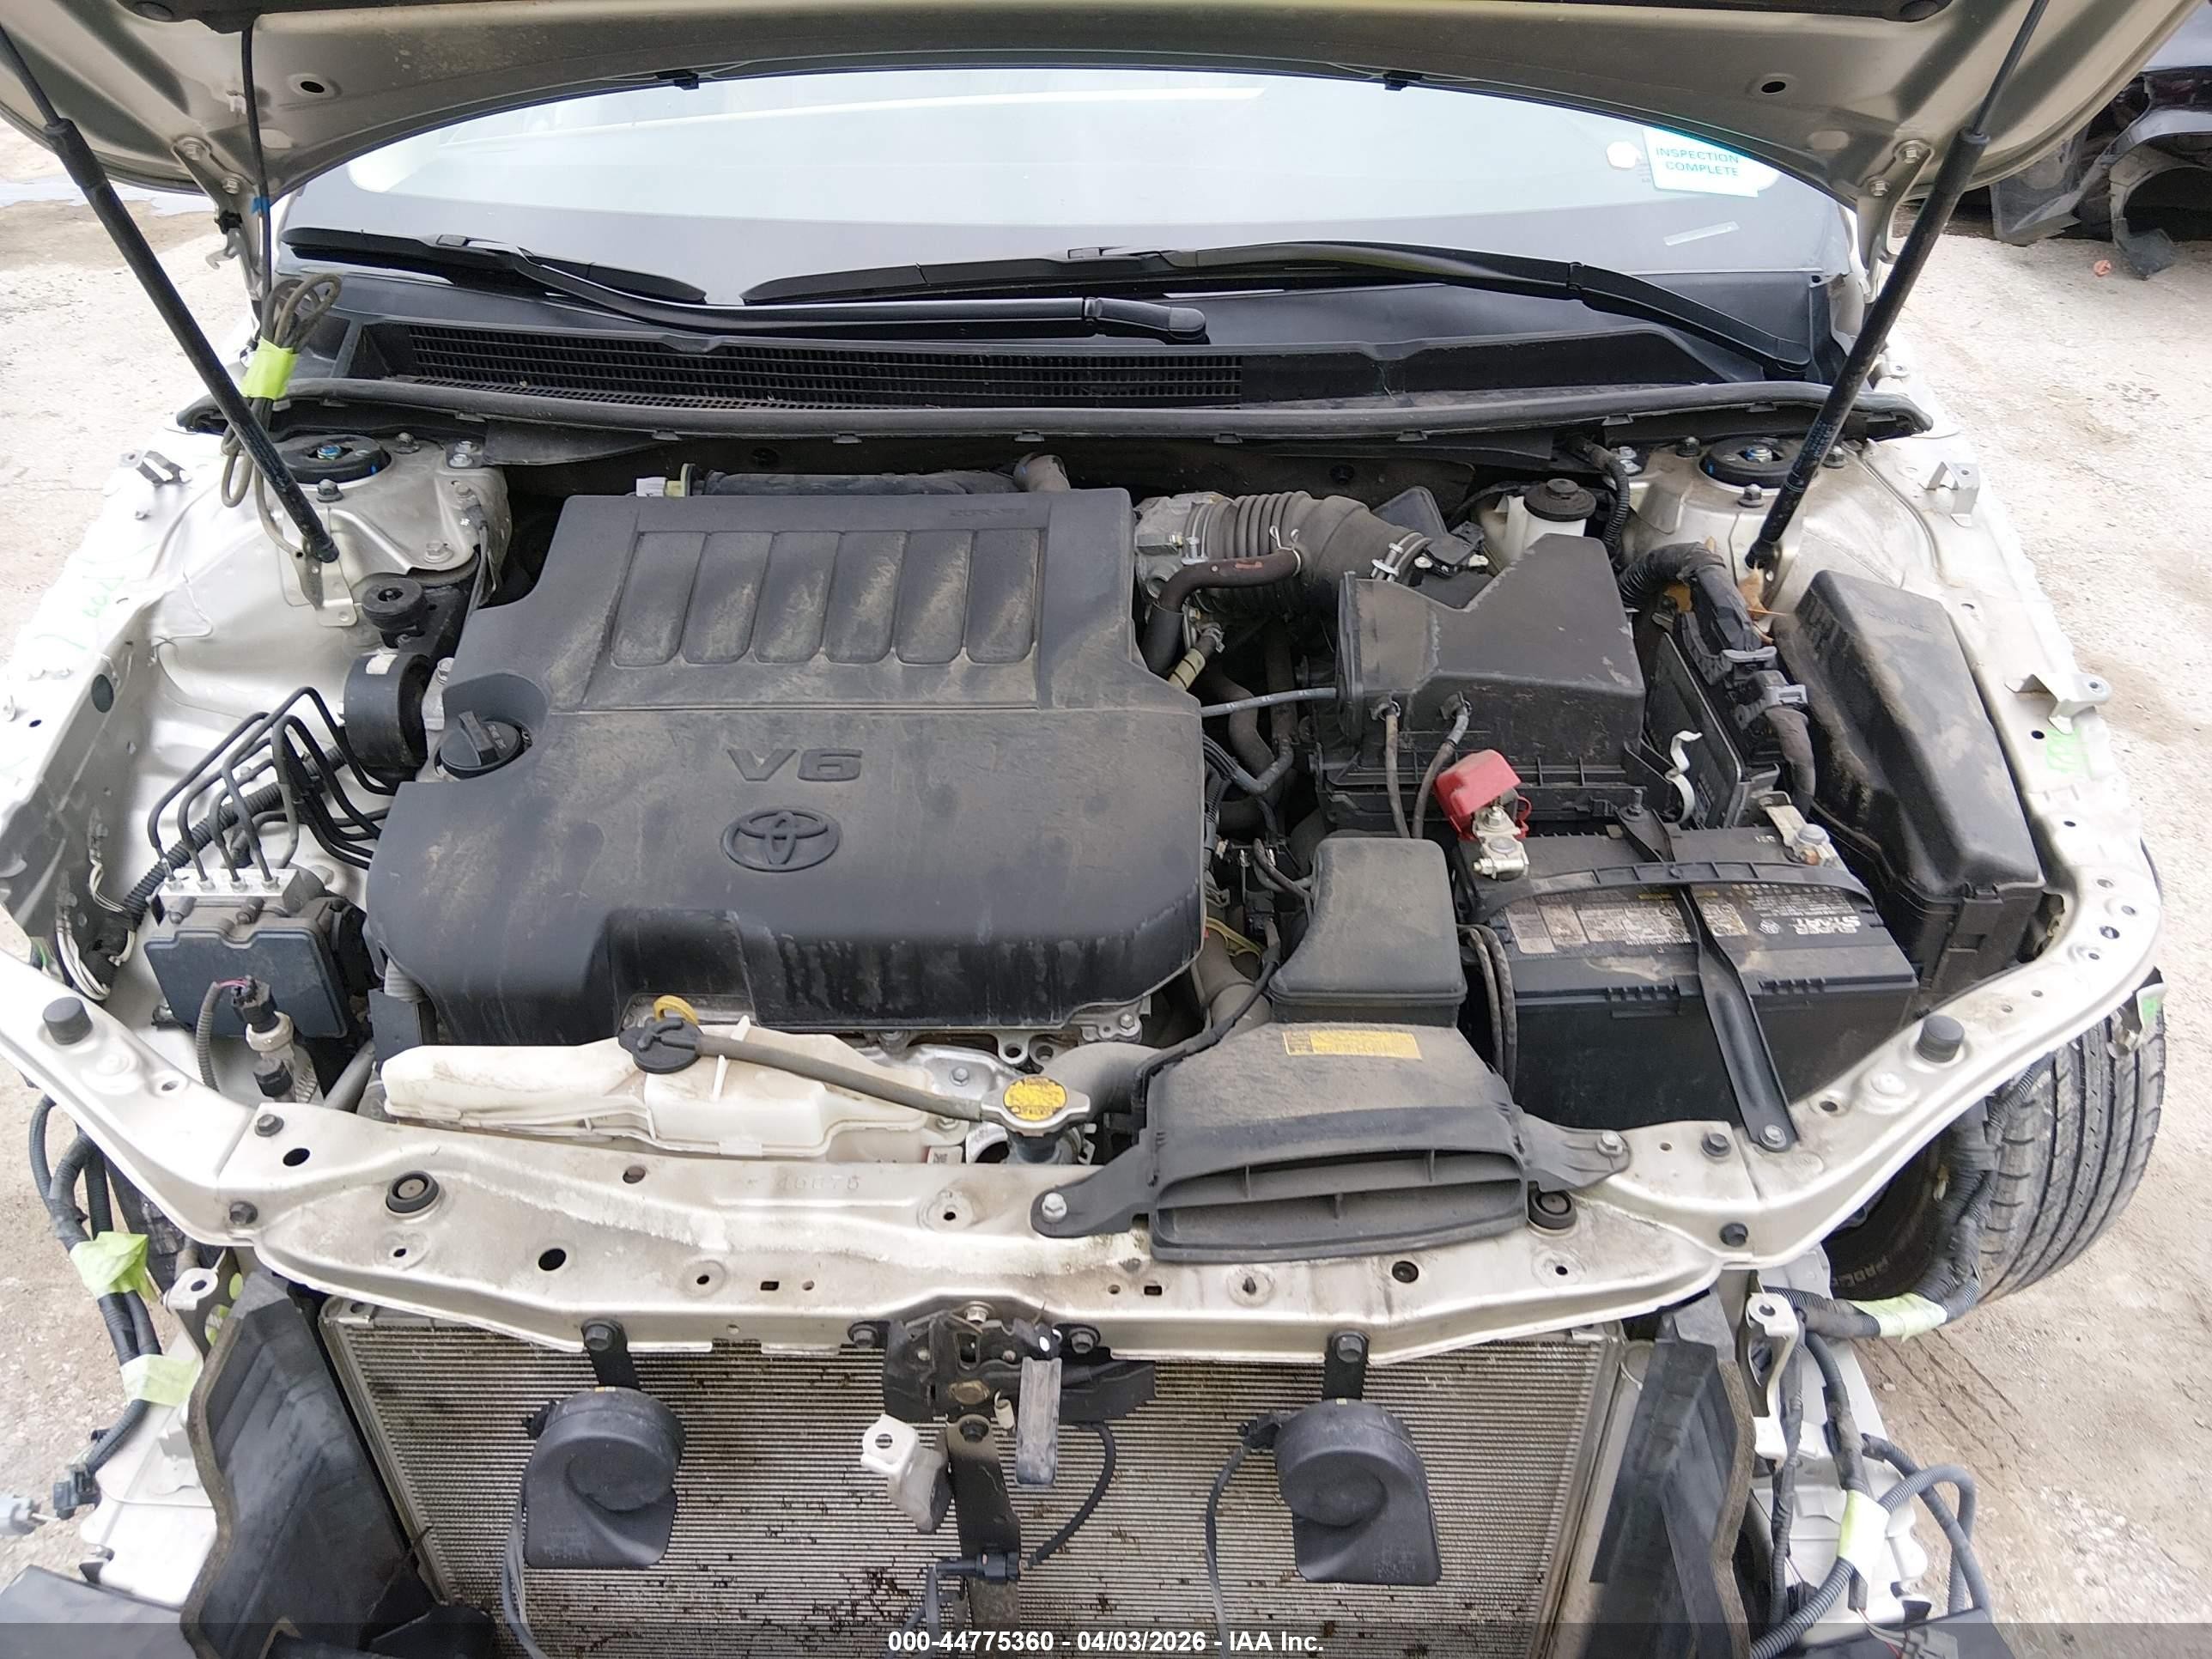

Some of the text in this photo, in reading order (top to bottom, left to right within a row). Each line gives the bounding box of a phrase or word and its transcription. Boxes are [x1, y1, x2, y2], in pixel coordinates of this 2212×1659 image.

[1656, 147, 1739, 164] INSPECTION
[1665, 161, 1739, 177] COMPLETE
[727, 749, 863, 781] V6
